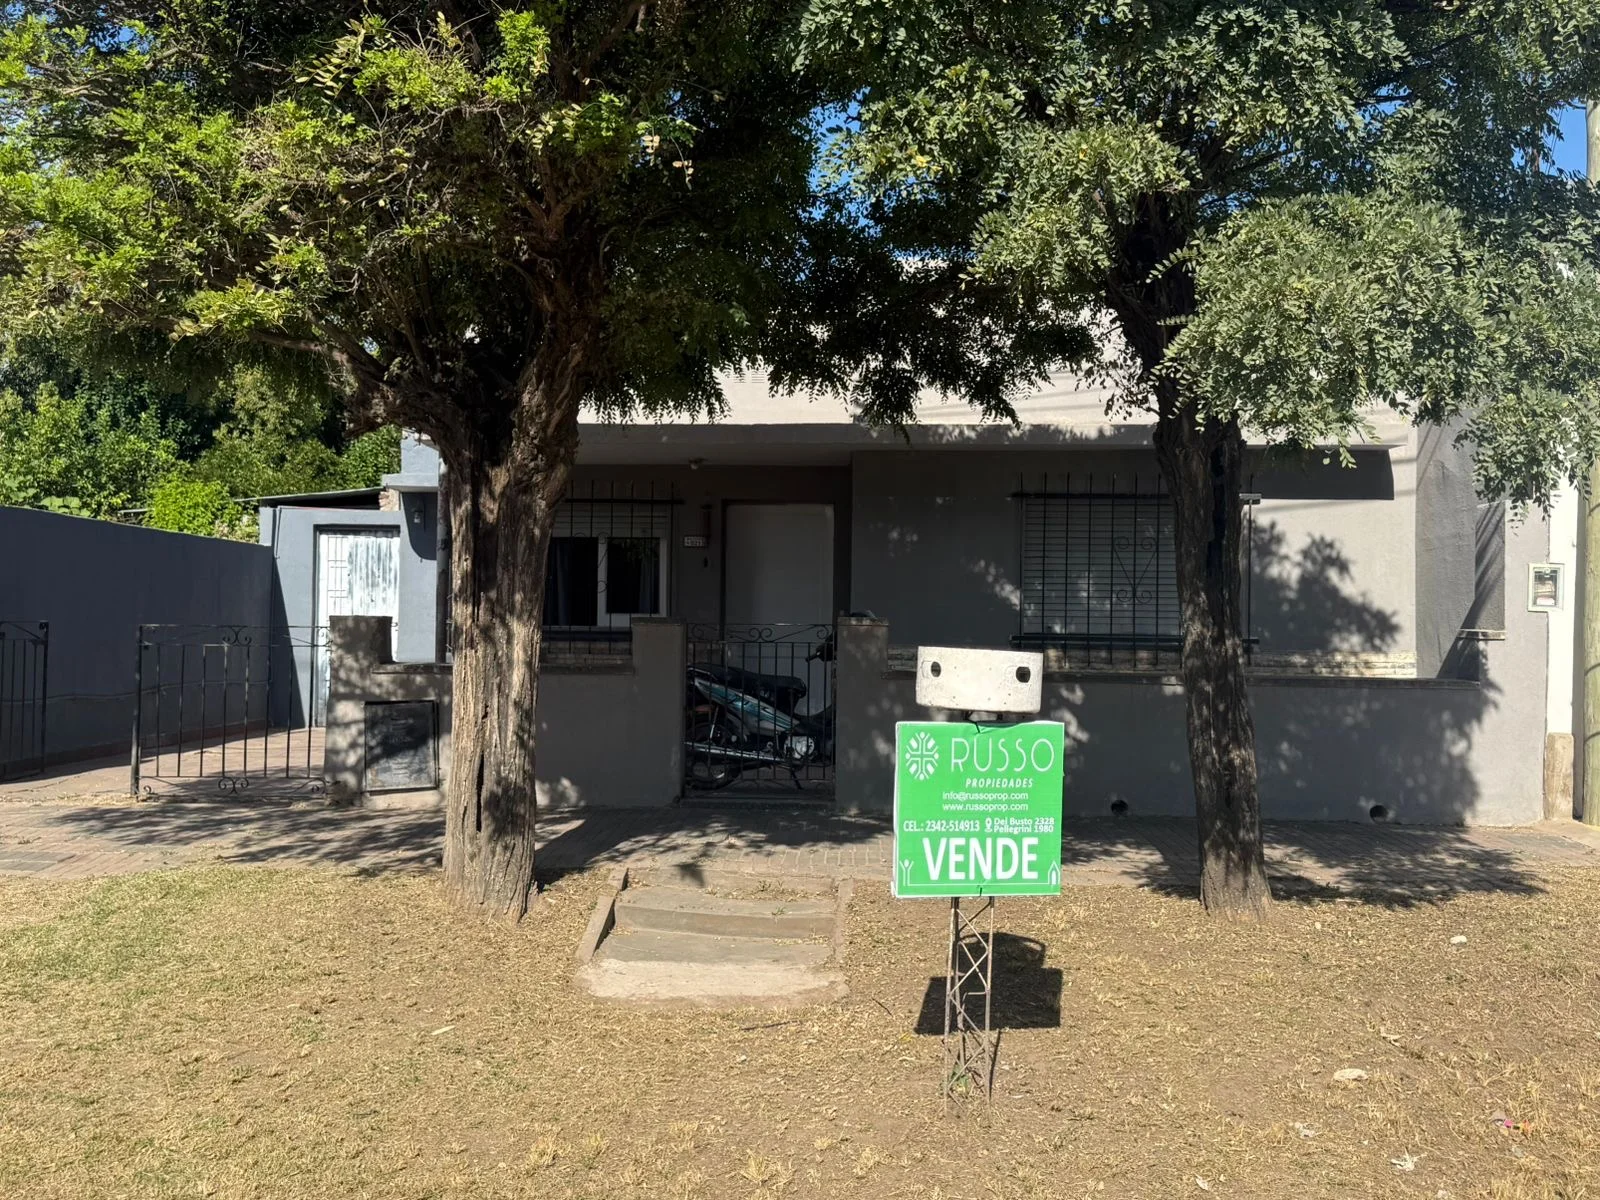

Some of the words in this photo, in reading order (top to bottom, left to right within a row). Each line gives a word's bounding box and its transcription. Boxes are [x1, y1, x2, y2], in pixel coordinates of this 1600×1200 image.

[951, 738, 1054, 772] RUSSO
[966, 778, 1033, 788] PROPIEDADES
[942, 792, 1028, 801] info@russoprop.com
[942, 803, 1028, 812] www.russoprop.com
[903, 820, 923, 832] CEL.:
[926, 820, 980, 832] 2342-514913
[994, 825, 1032, 834] Pellegrini
[1034, 825, 1054, 833] 1980
[922, 838, 1038, 880] VENDE
